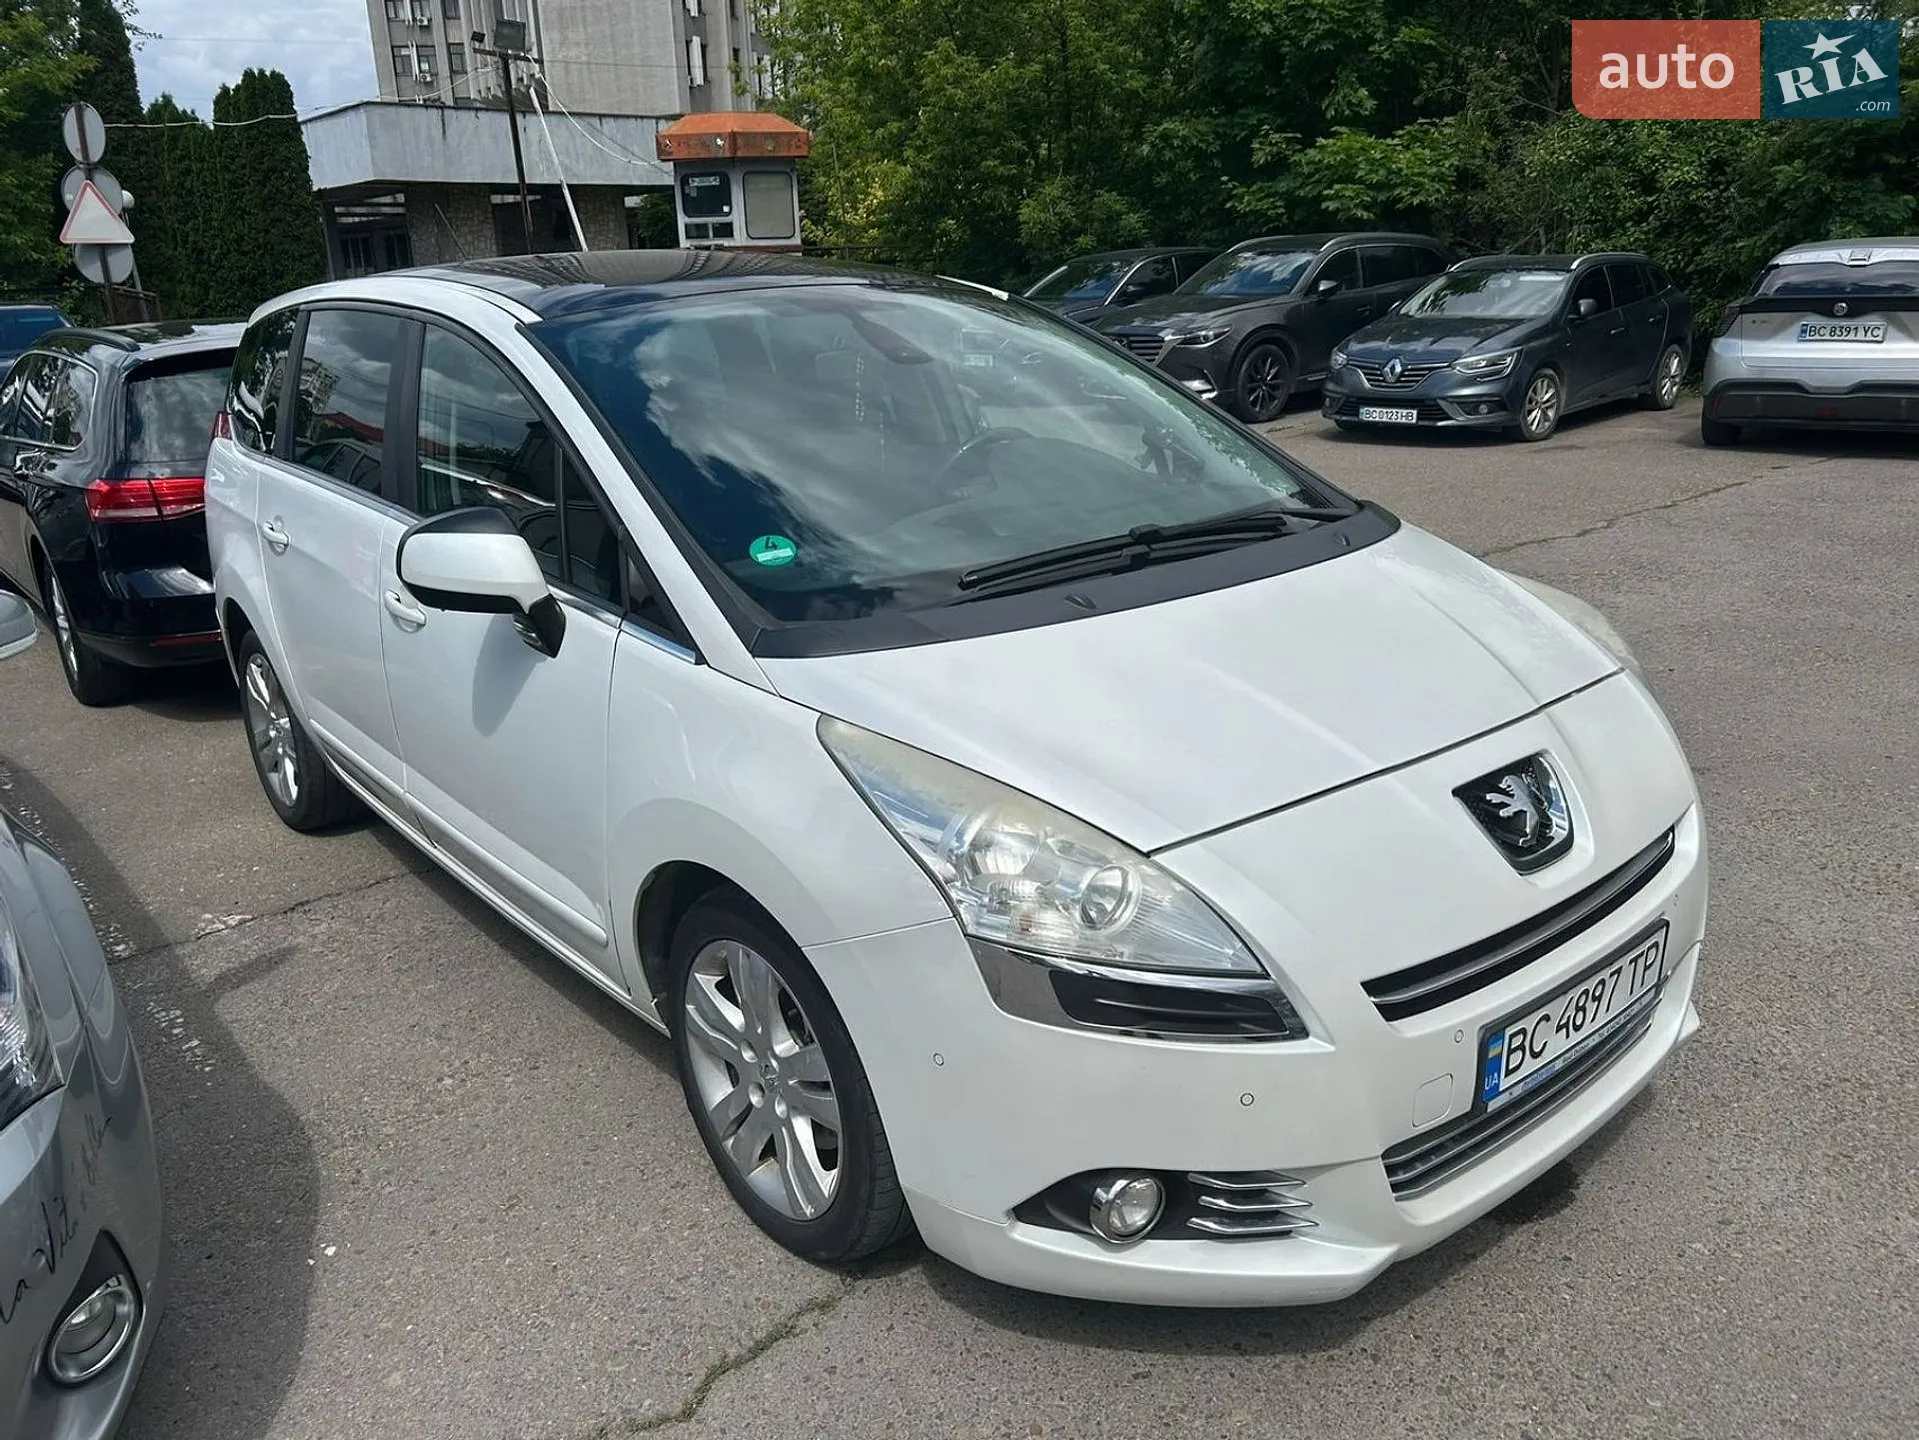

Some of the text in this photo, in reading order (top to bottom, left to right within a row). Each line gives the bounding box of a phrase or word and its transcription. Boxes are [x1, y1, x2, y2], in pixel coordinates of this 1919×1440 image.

[1808, 325, 1881, 338] BC 8391 YC
[1365, 409, 1378, 419] BC
[764, 536, 778, 550] 4
[1503, 1013, 1551, 1079] BC
[1555, 965, 1624, 1039] 4897
[1628, 940, 1660, 996] TP
[1484, 1073, 1499, 1090] UA
